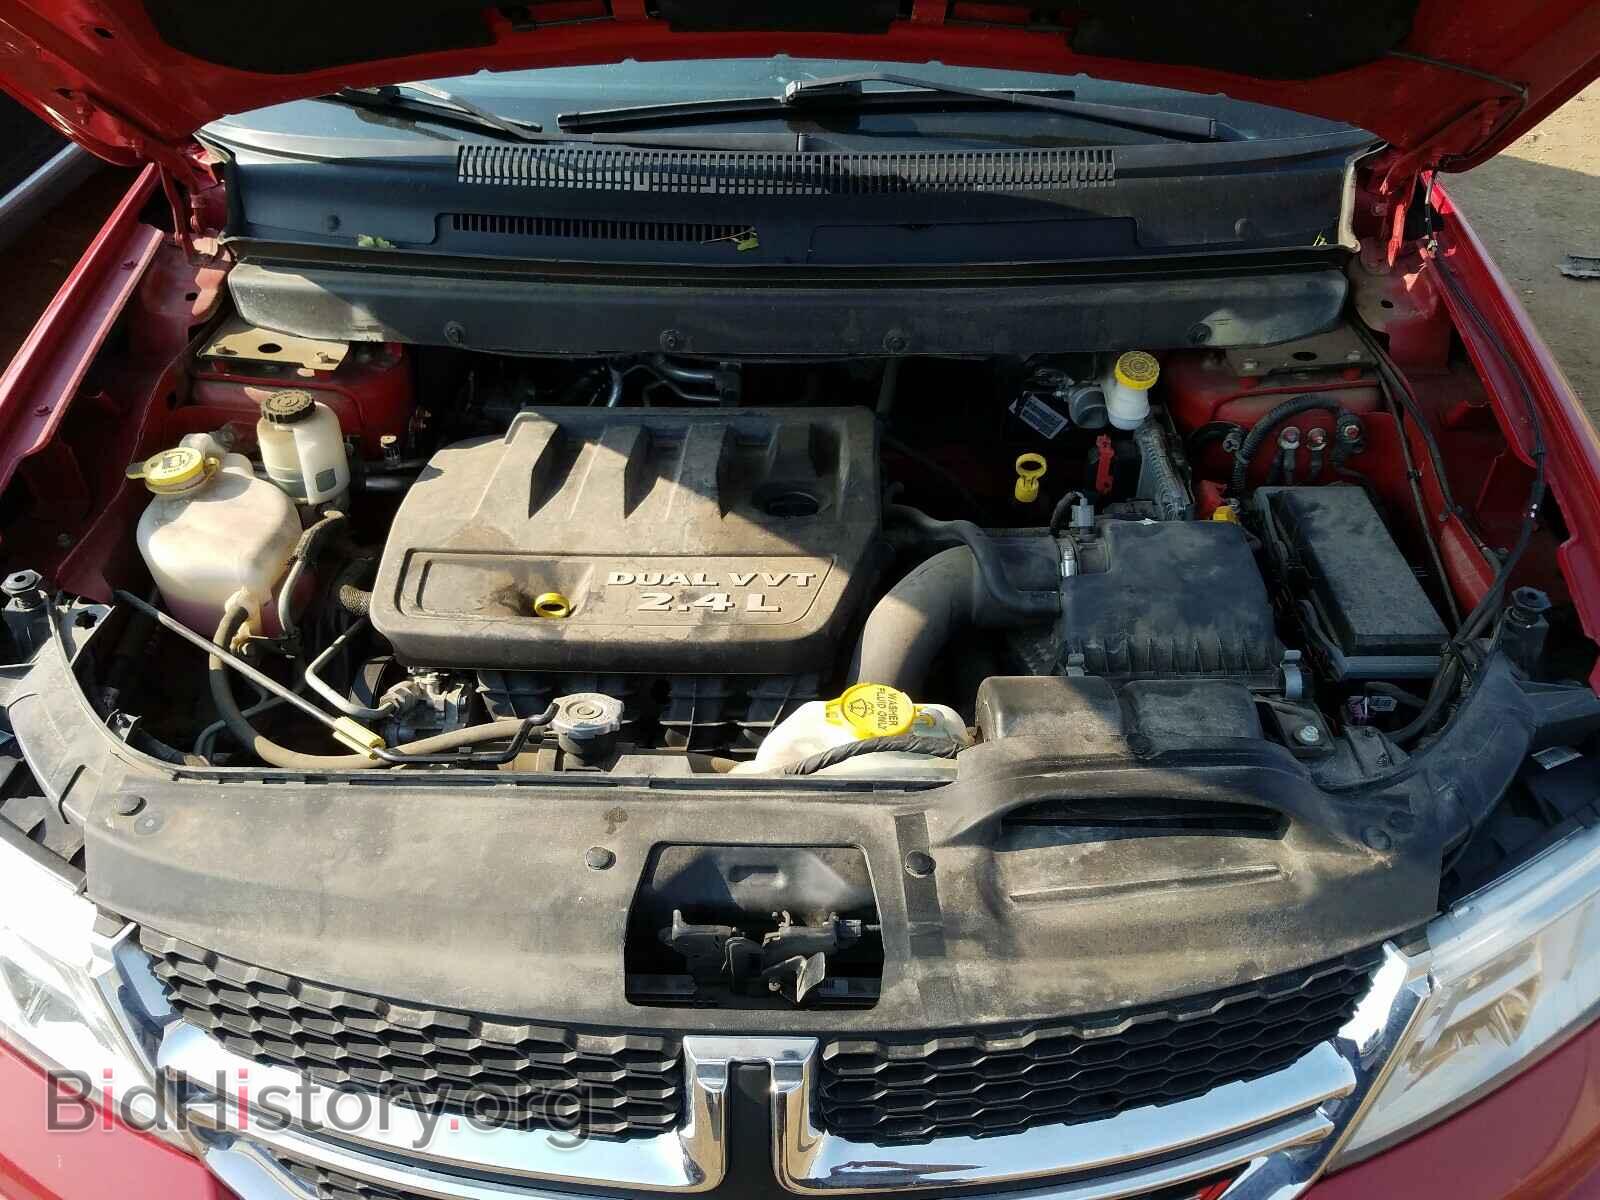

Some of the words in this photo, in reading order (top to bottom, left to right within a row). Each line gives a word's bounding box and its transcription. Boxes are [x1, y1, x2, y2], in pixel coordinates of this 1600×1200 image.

[608, 571, 719, 586] DUAL
[728, 572, 816, 586] VVT
[876, 688, 887, 709] FLUID
[887, 692, 898, 726] WASHER
[877, 711, 888, 731] ONLY
